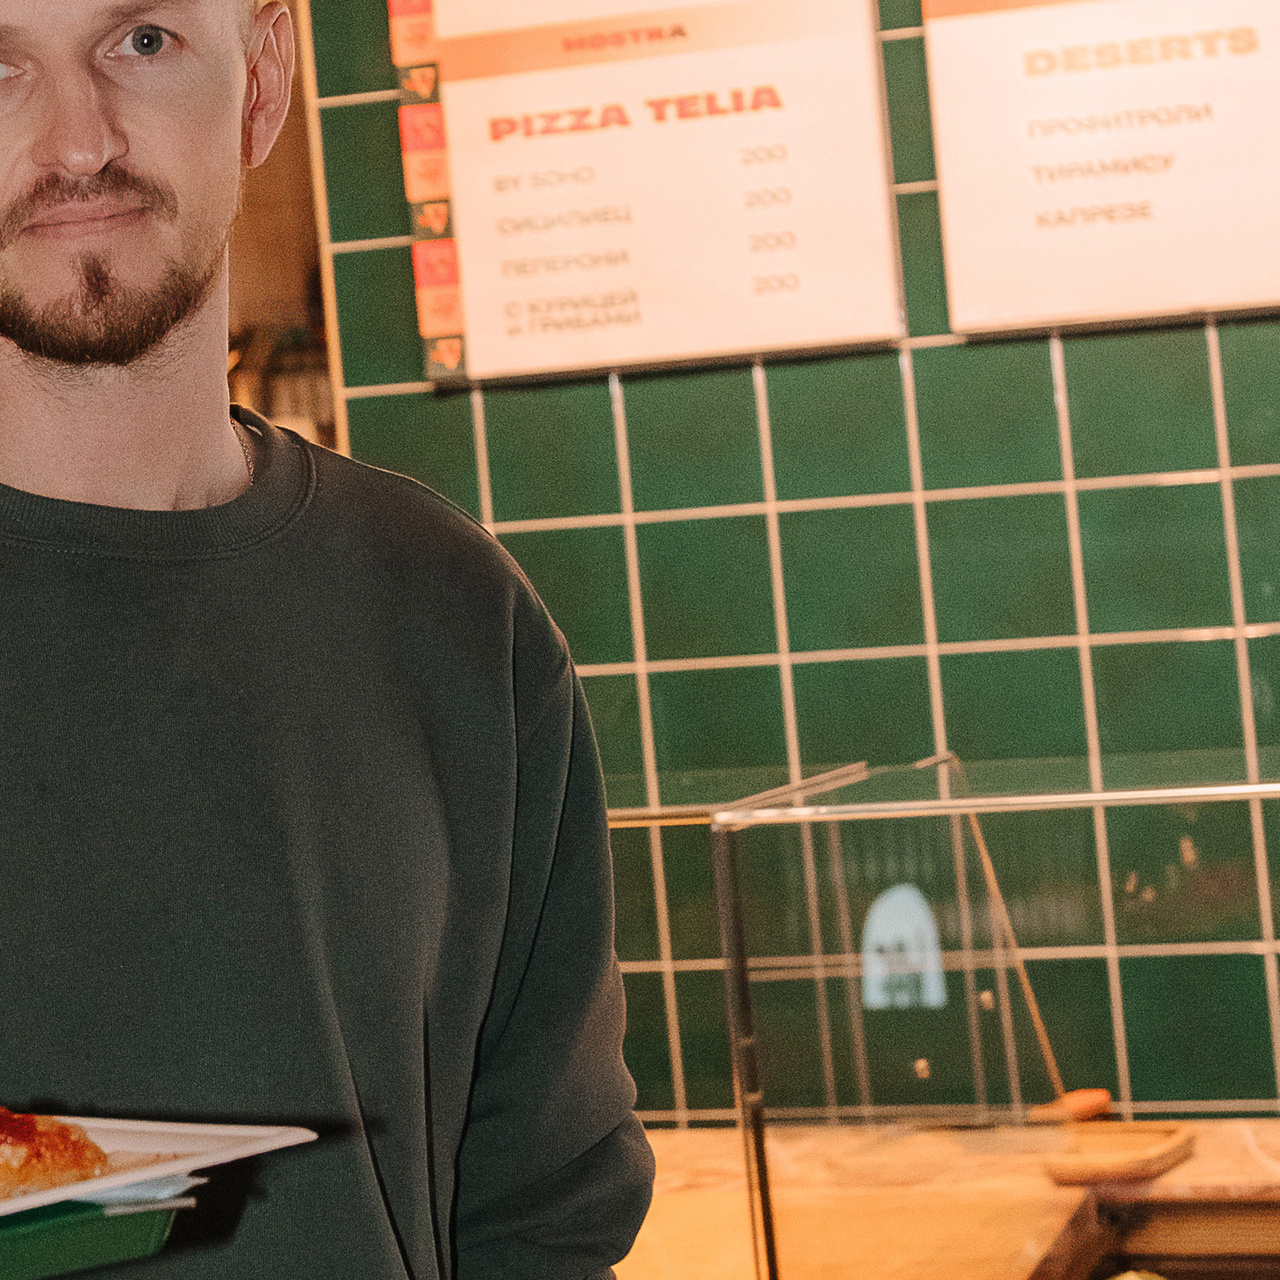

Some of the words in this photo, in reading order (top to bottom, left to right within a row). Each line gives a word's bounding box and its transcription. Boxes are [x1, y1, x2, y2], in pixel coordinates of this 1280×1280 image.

[562, 23, 686, 51] MOSTRA
[1024, 26, 1260, 77] DESERTS
[488, 103, 632, 143] PIZZA
[645, 85, 784, 123] TELIA
